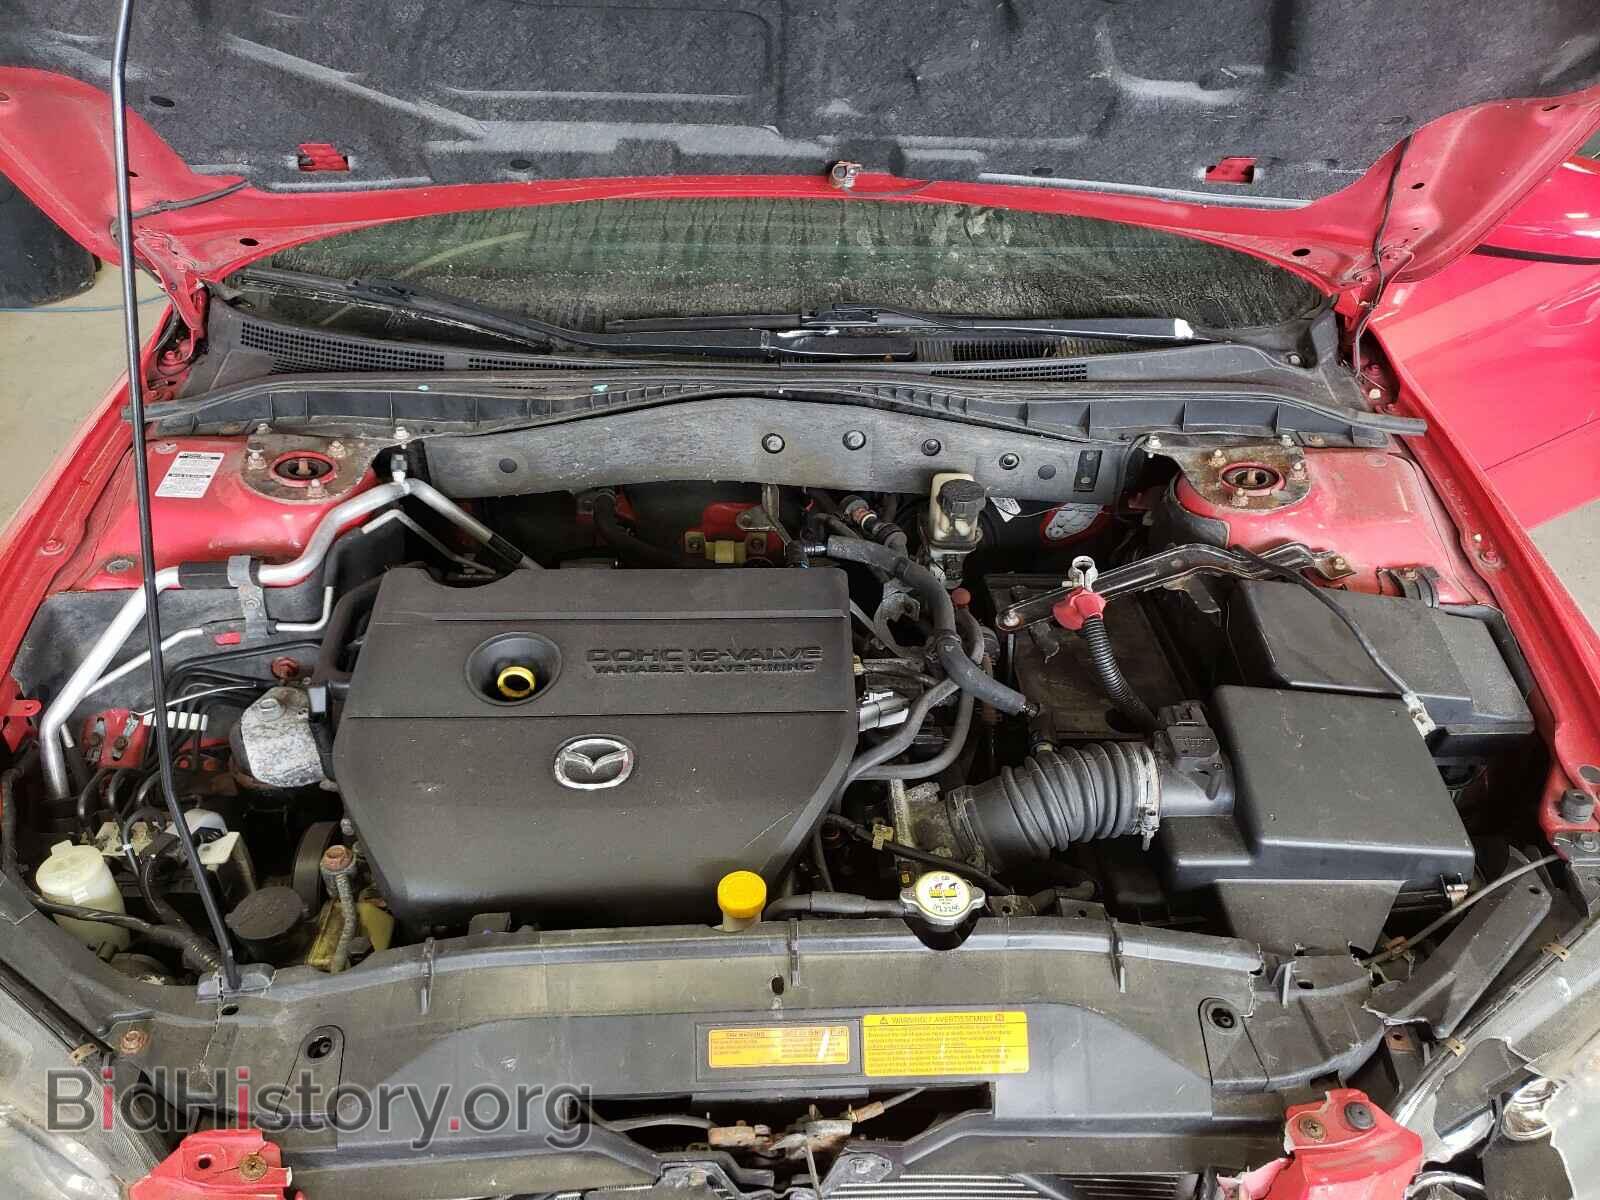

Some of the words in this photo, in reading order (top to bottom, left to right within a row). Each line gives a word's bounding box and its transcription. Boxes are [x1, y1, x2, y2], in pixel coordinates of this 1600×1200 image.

[689, 646, 823, 662] 16-VALVE
[592, 664, 684, 673] VARIABLE
[687, 664, 745, 673] VALVE
[751, 662, 817, 673] TIMING
